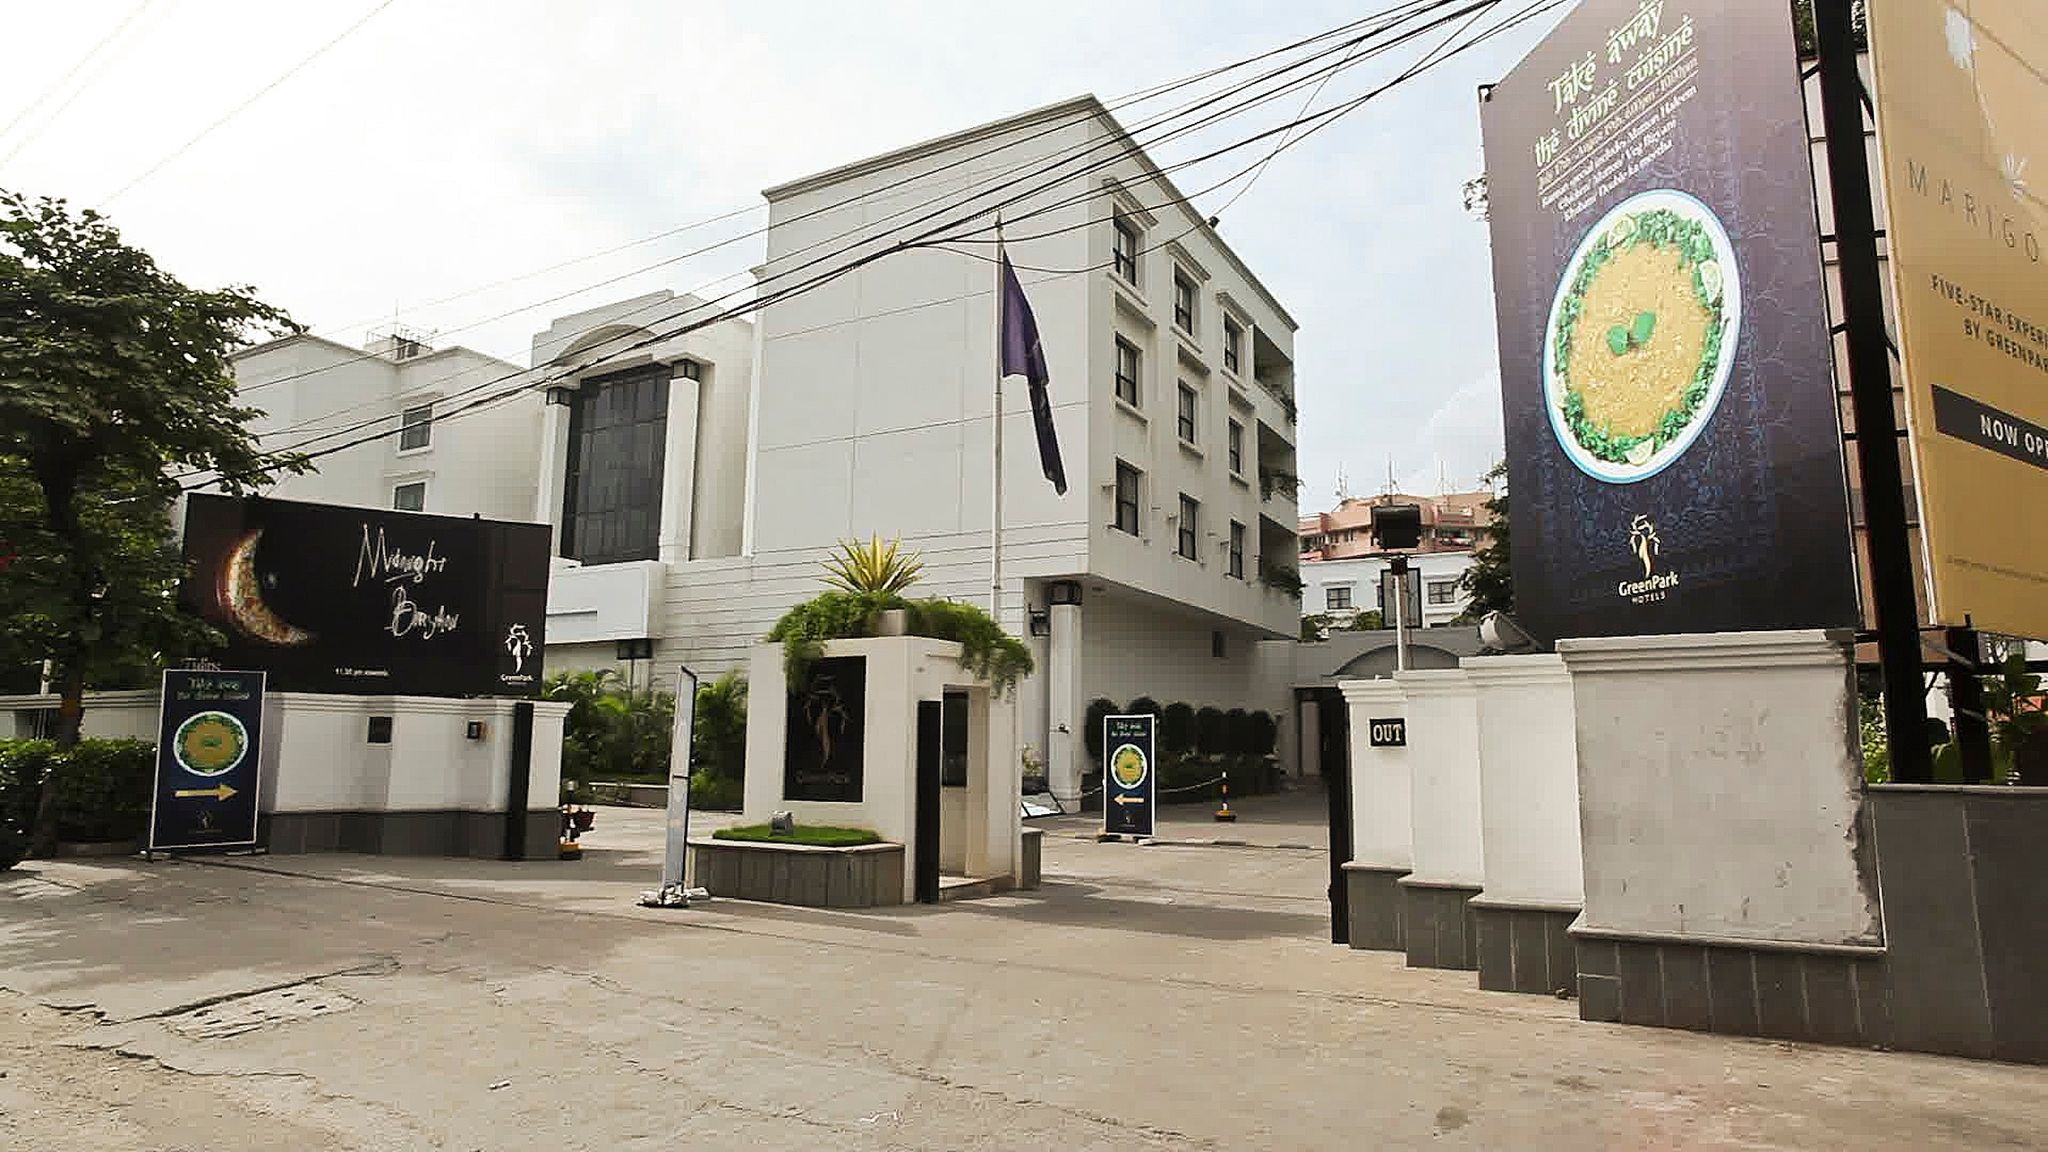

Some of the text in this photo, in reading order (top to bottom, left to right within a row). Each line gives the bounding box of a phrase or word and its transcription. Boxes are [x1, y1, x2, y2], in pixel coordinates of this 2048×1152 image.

[1534, 128, 1560, 167] the
[1565, 79, 1619, 140] divine
[1624, 15, 1693, 90] cuisine
[1964, 318, 1980, 339] BY
[1980, 415, 2018, 447] NOW
[1618, 571, 1680, 597] GreenPark
[1373, 723, 1402, 742] OUT
